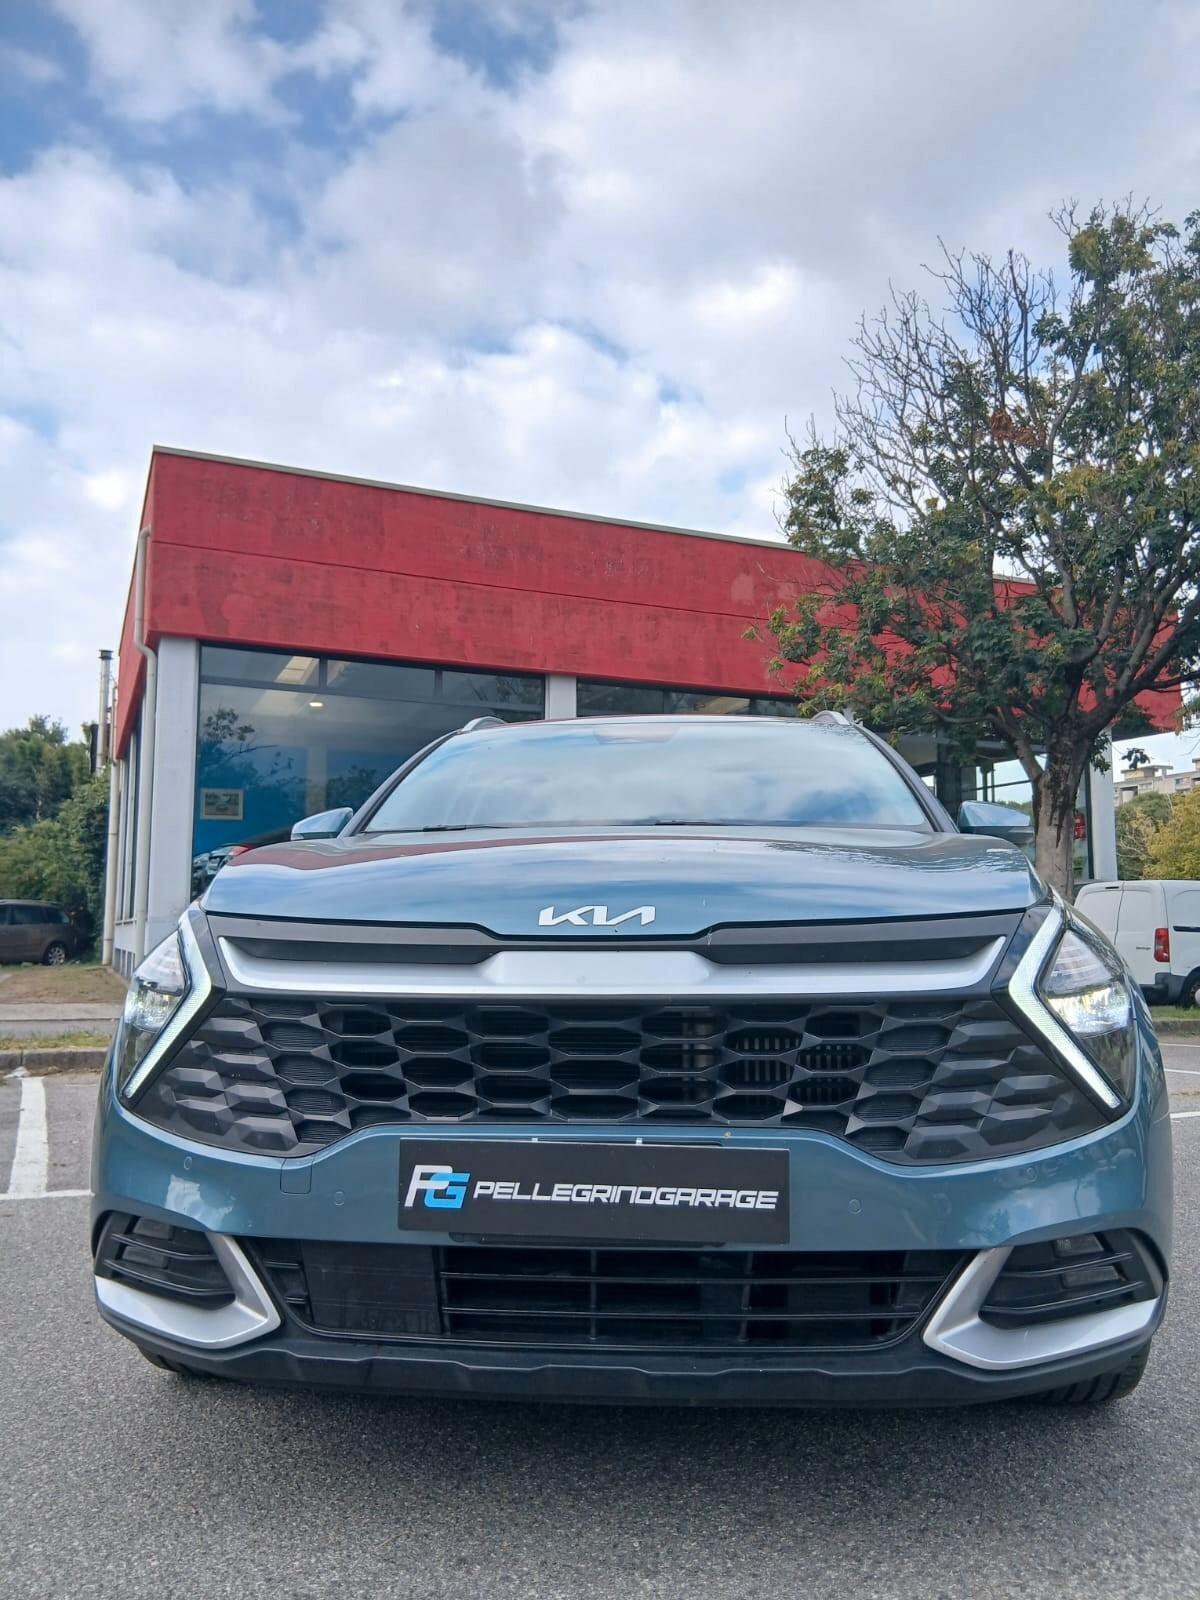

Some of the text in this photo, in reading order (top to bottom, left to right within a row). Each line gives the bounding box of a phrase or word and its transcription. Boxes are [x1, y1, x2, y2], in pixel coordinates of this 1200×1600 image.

[538, 905, 656, 926] KIA
[404, 1165, 779, 1209] PG PELLEGRINOGARAGE
